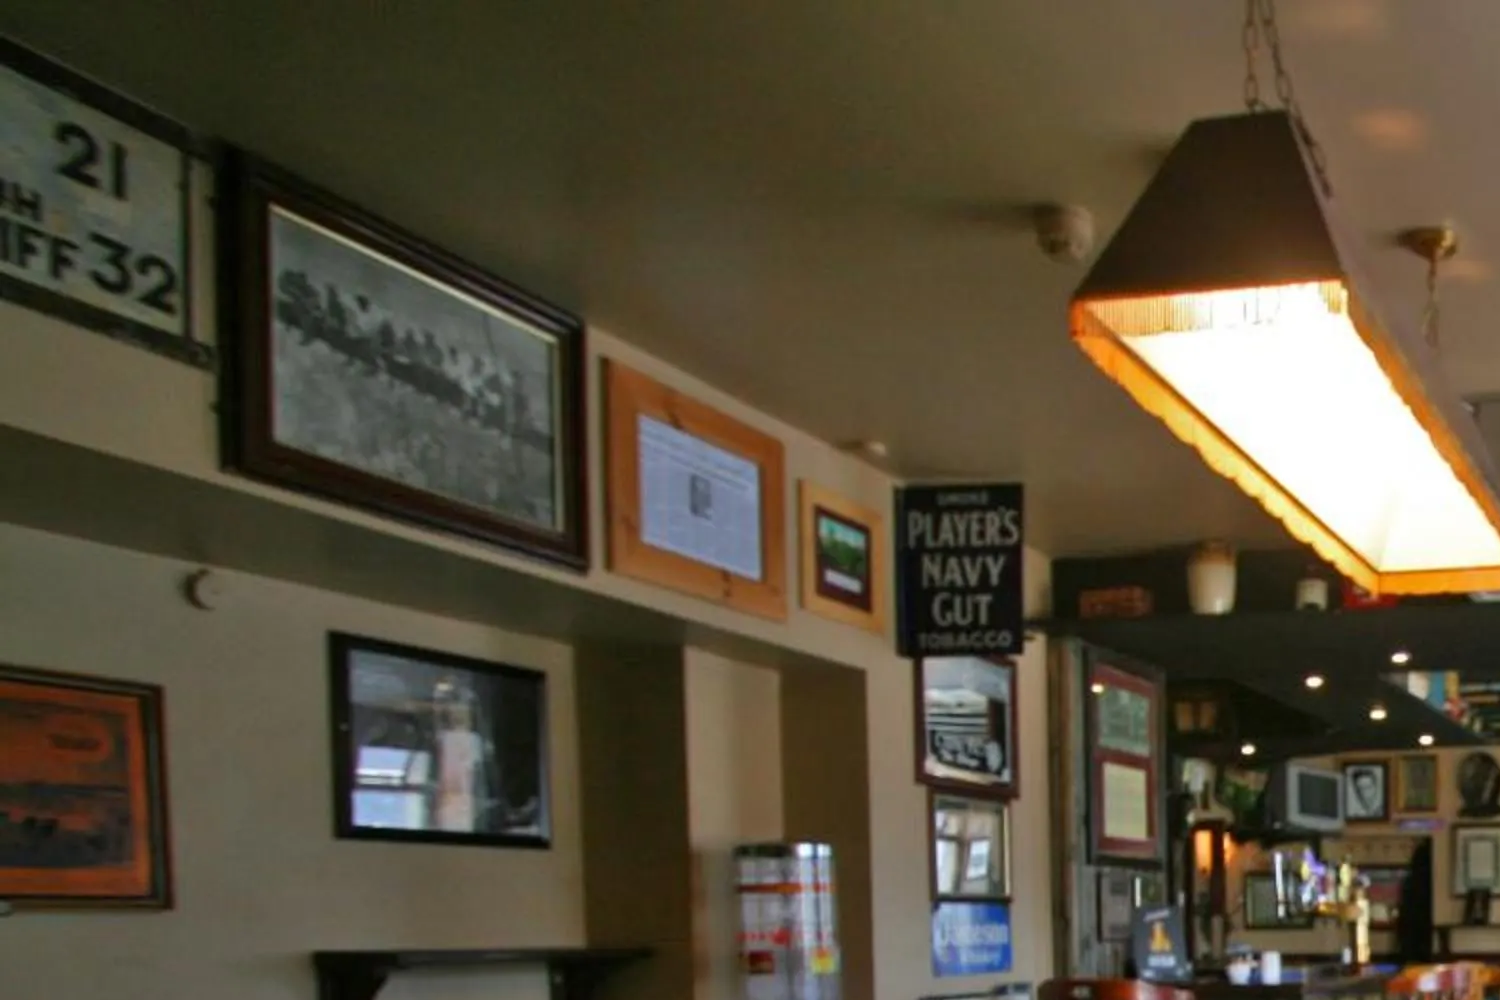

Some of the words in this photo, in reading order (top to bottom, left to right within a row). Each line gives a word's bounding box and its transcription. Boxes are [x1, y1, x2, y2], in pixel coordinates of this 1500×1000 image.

[55, 120, 128, 202] 21
[87, 231, 178, 317] 32
[907, 506, 1020, 549] PLAYER'S
[921, 553, 1006, 589] NAVY
[917, 629, 1013, 650] TOBACCO
